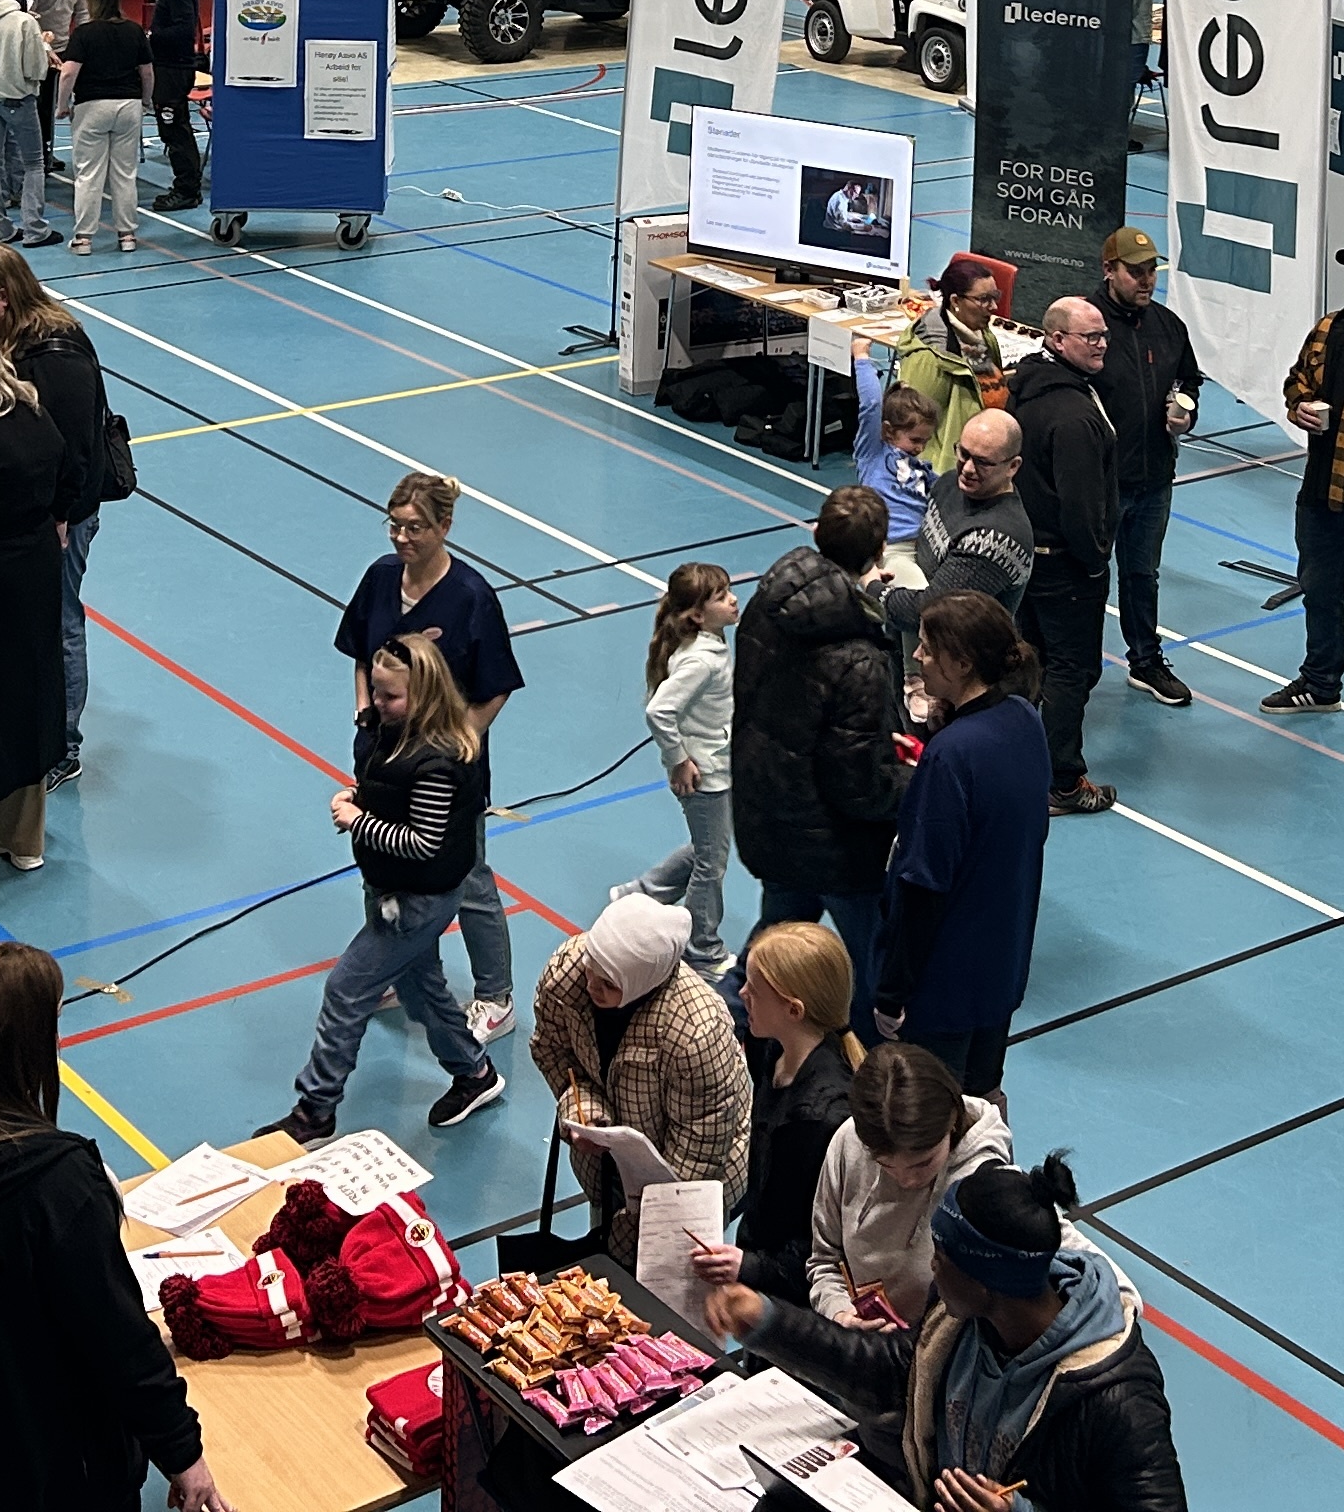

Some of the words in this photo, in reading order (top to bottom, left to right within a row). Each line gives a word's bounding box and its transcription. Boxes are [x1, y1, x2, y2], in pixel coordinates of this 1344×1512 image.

[1024, 10, 1102, 29] lederne
[999, 159, 1044, 181] FOR
[1050, 166, 1095, 188] DEG
[996, 182, 1044, 203] SOM
[1049, 188, 1097, 211] GÅR
[1007, 204, 1083, 231] FORAN
[647, 230, 689, 241] THOMSO
[1004, 248, 1085, 269] www.lederne.no
